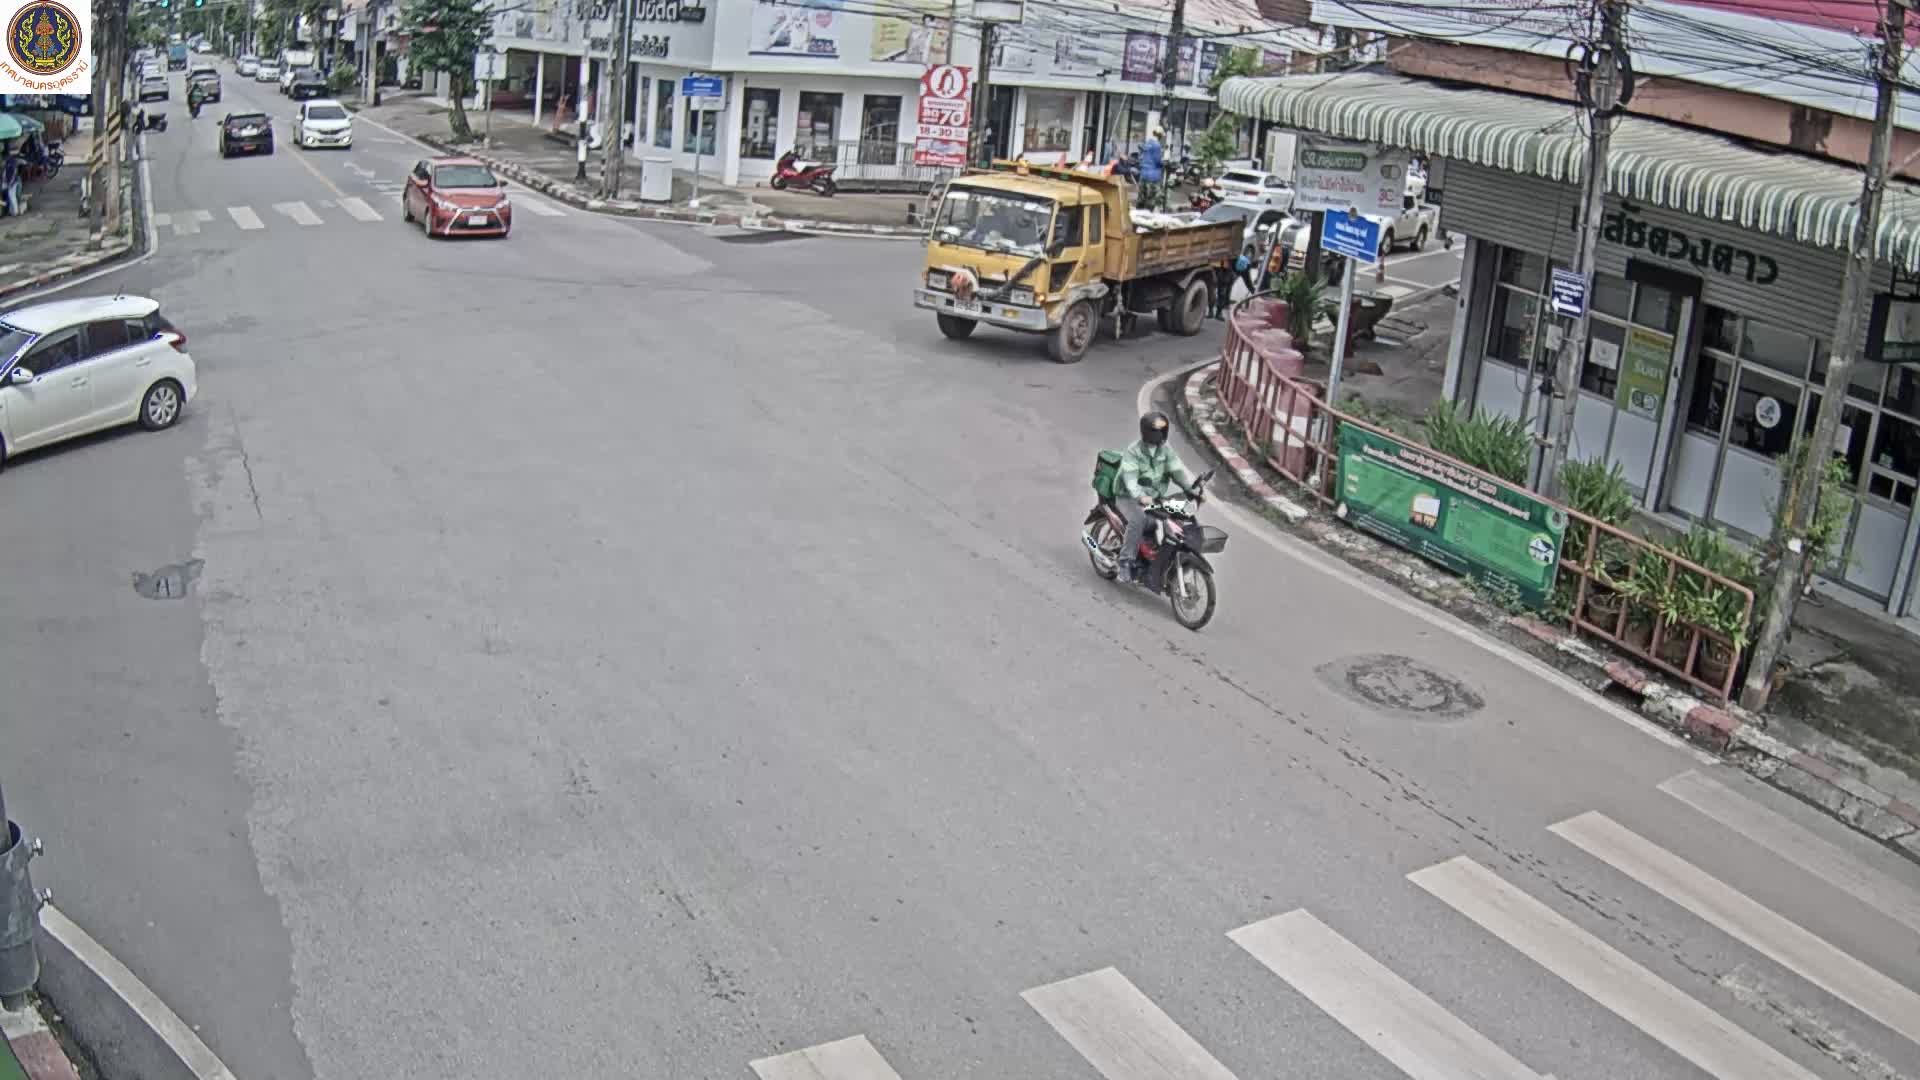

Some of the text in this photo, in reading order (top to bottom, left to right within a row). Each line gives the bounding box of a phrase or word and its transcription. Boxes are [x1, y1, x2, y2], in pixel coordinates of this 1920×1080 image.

[939, 110, 965, 126] 70
[1571, 200, 1779, 285] เสัชดวงดาว
